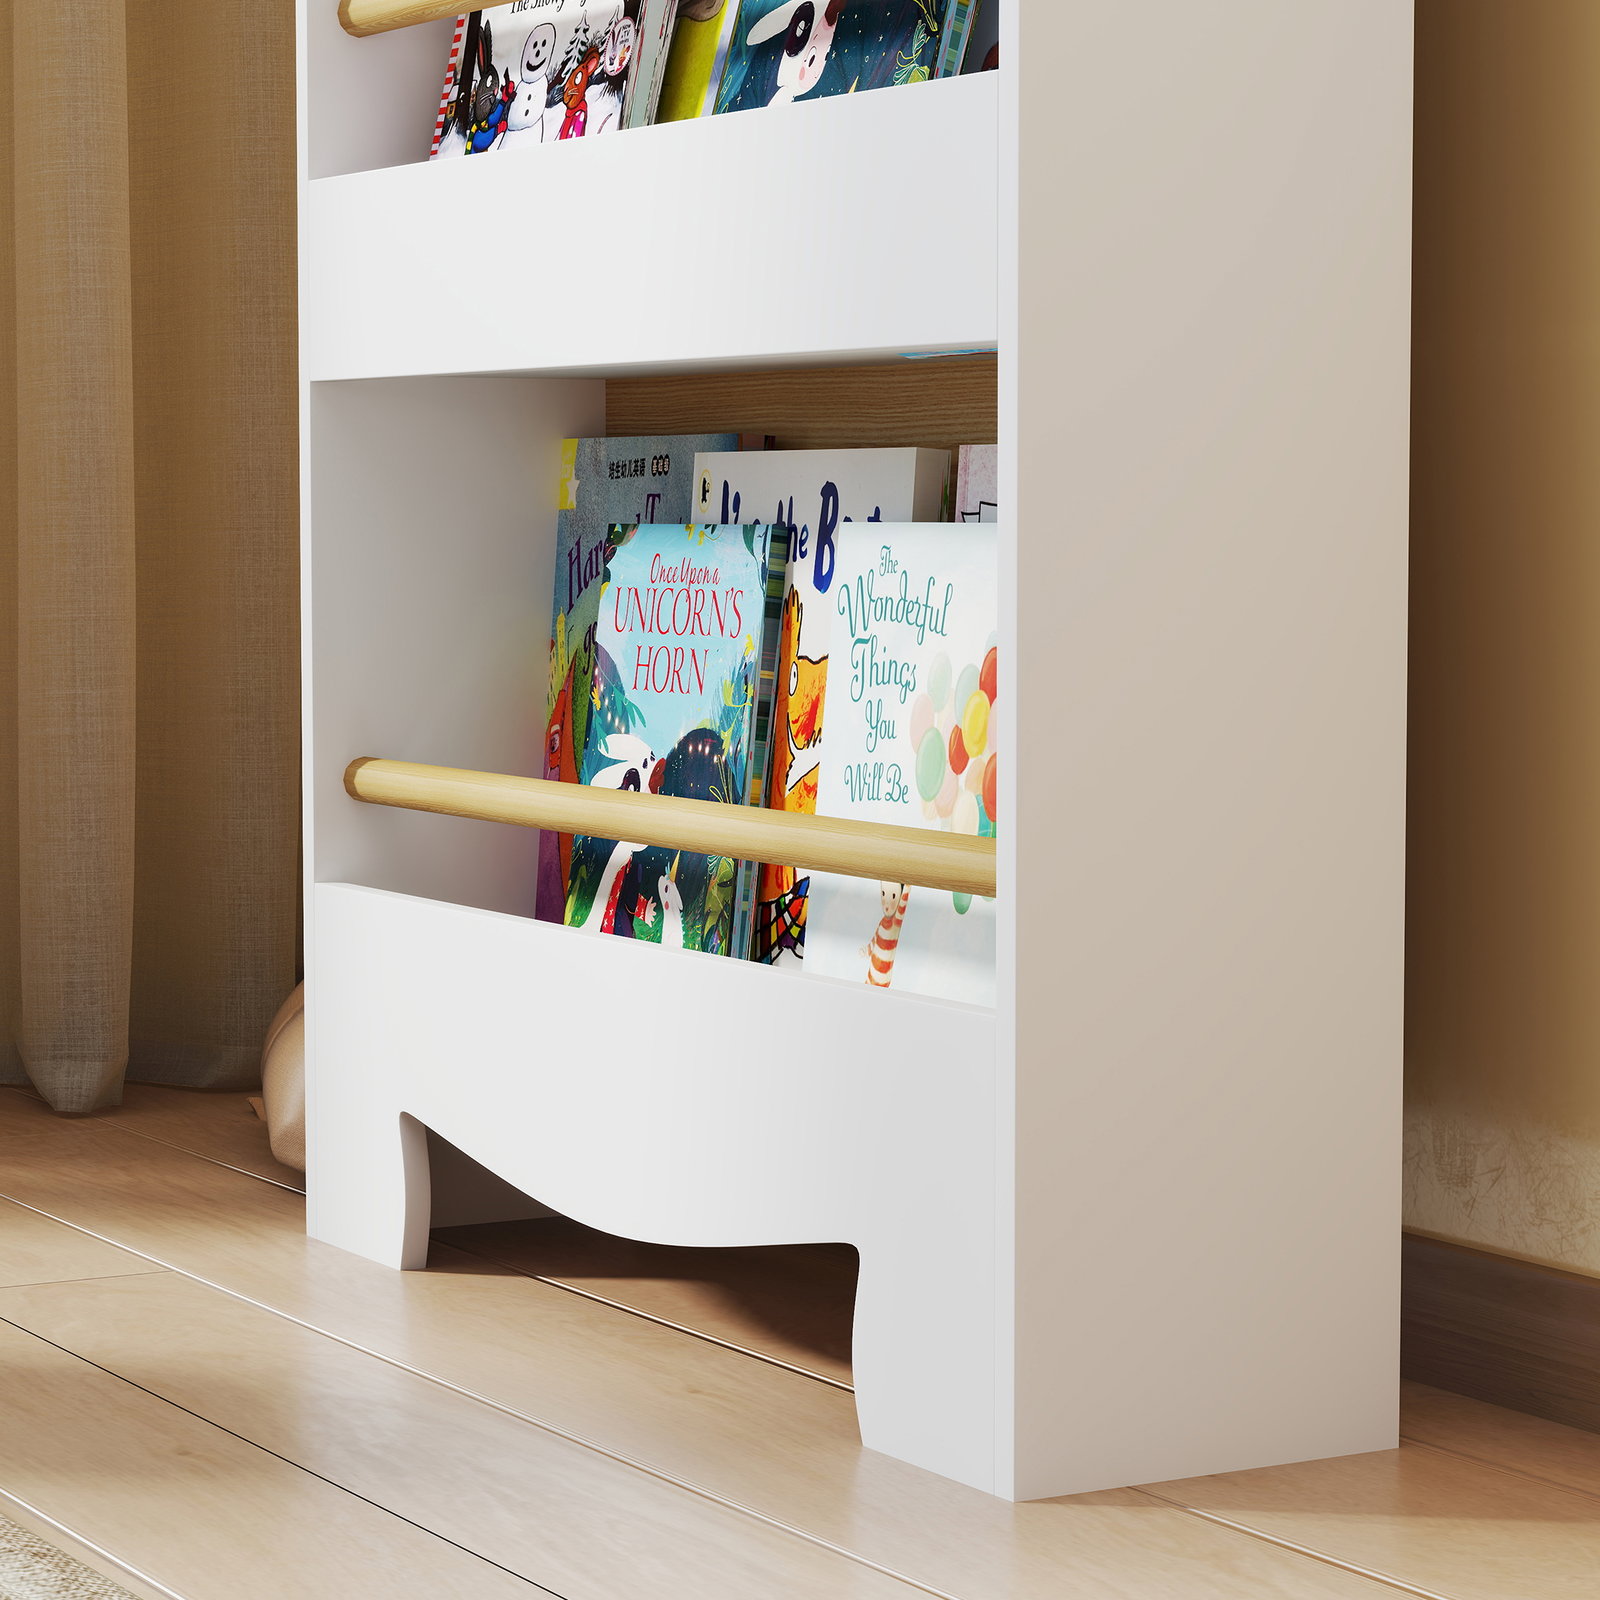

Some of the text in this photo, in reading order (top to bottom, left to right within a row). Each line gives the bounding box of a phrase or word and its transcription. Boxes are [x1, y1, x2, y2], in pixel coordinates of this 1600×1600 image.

[608, 458, 646, 480] 培生幼儿英语
[650, 553, 721, 603] Once Upon a
[879, 545, 898, 576] The
[613, 586, 744, 639] UNICORN'S
[837, 569, 954, 645] Wonderful
[632, 645, 709, 696] HORN
[850, 634, 917, 704] Things
[865, 699, 897, 753] You
[844, 762, 910, 804] Will Be
